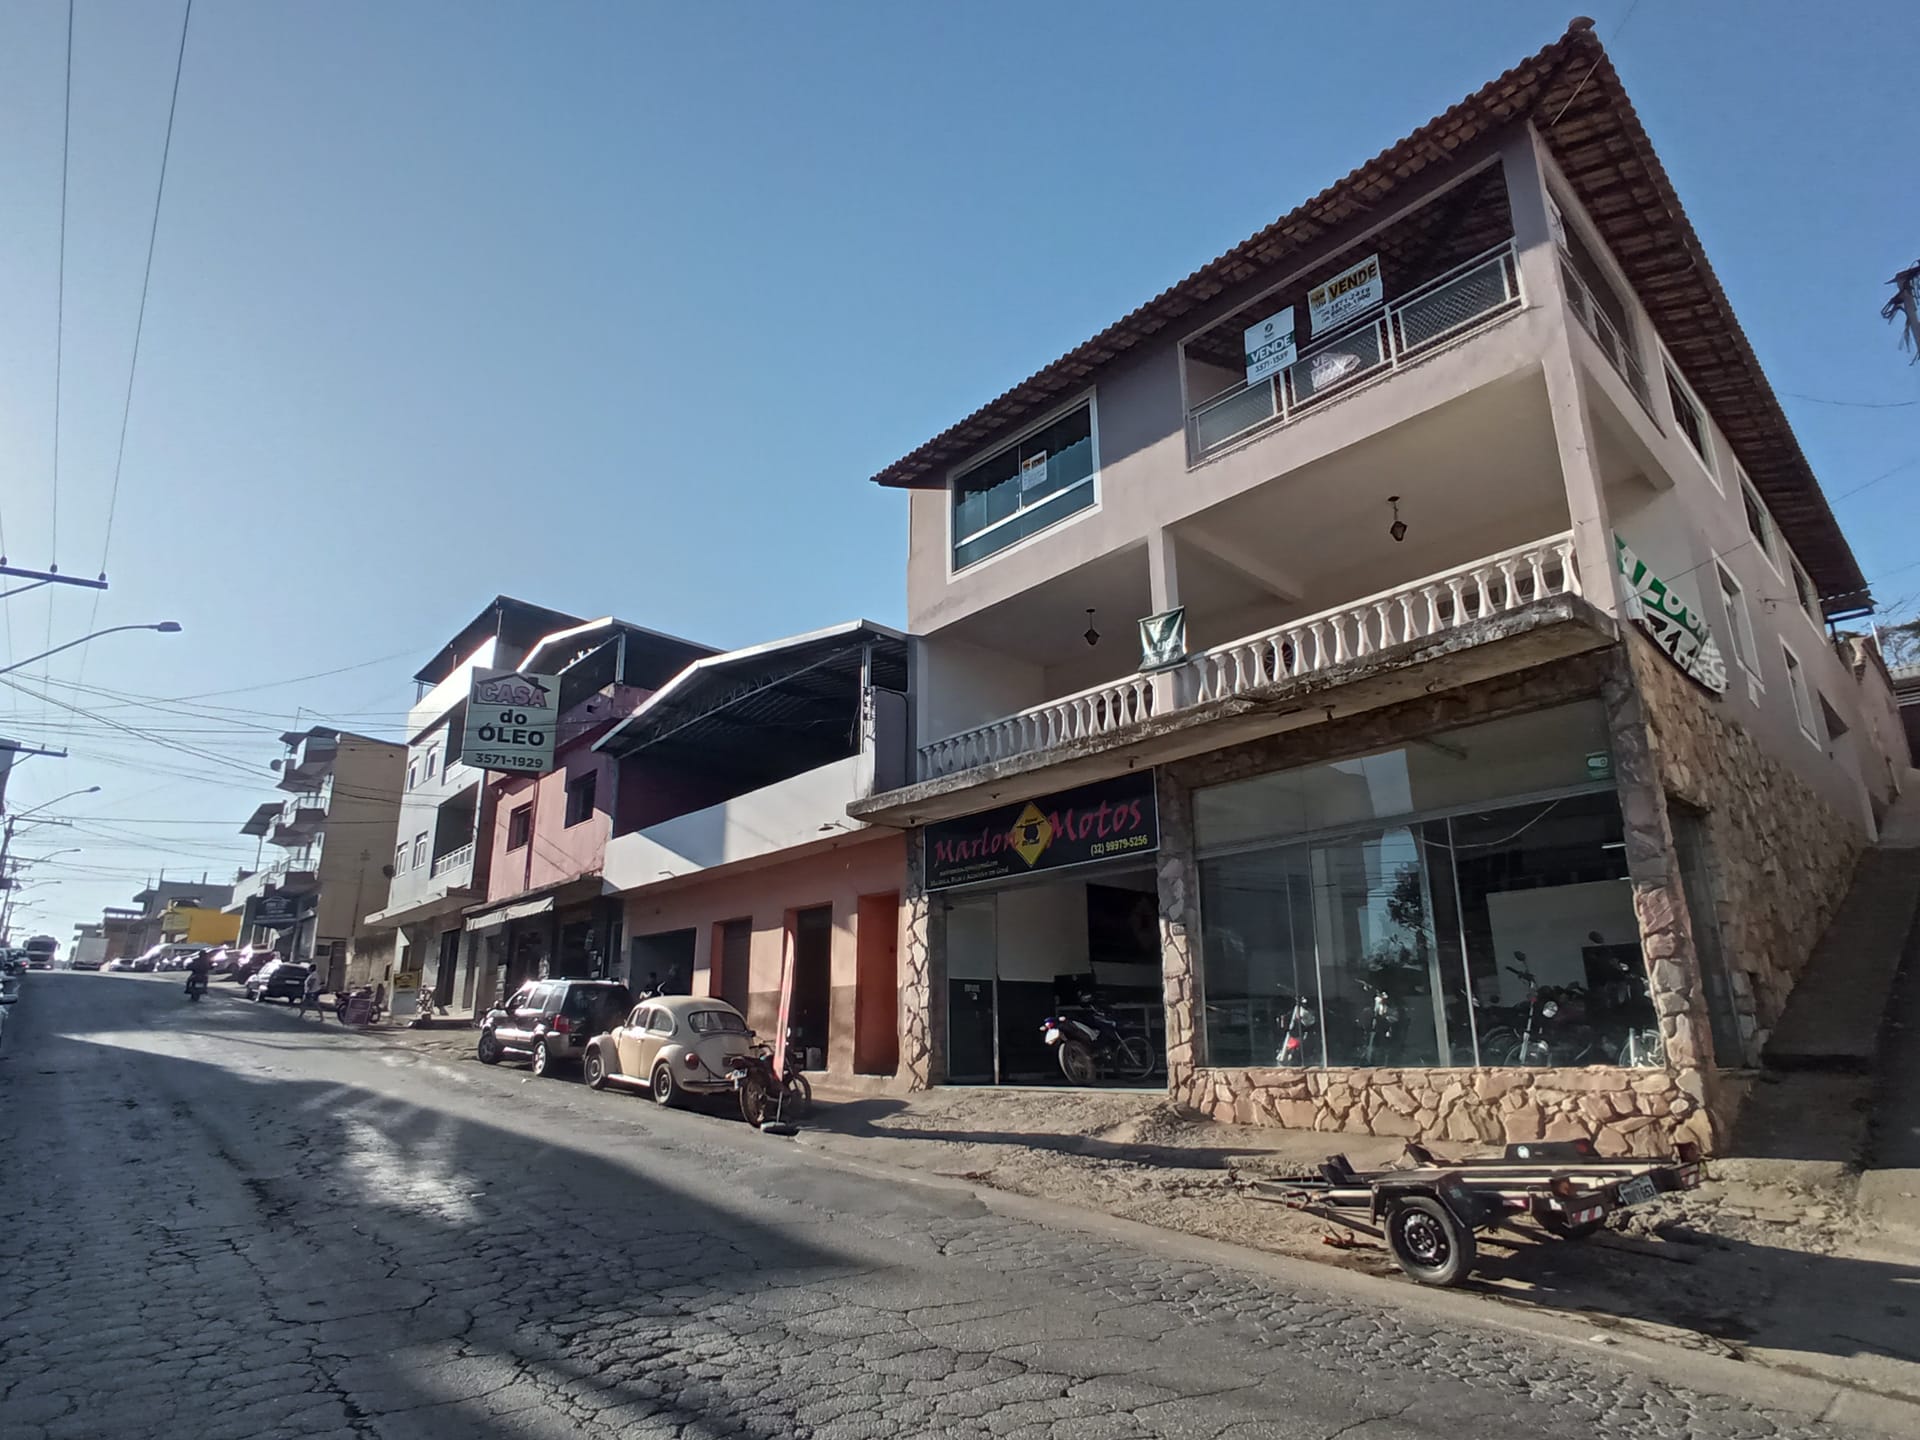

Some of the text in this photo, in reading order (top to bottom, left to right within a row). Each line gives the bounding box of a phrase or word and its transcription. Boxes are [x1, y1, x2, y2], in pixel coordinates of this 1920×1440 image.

[1327, 262, 1377, 299] VENDE
[1251, 334, 1291, 363] VENDE
[480, 683, 547, 708] CASA
[500, 709, 527, 725] do
[478, 722, 544, 746] ÓLEO
[475, 753, 543, 768] 3571-1929
